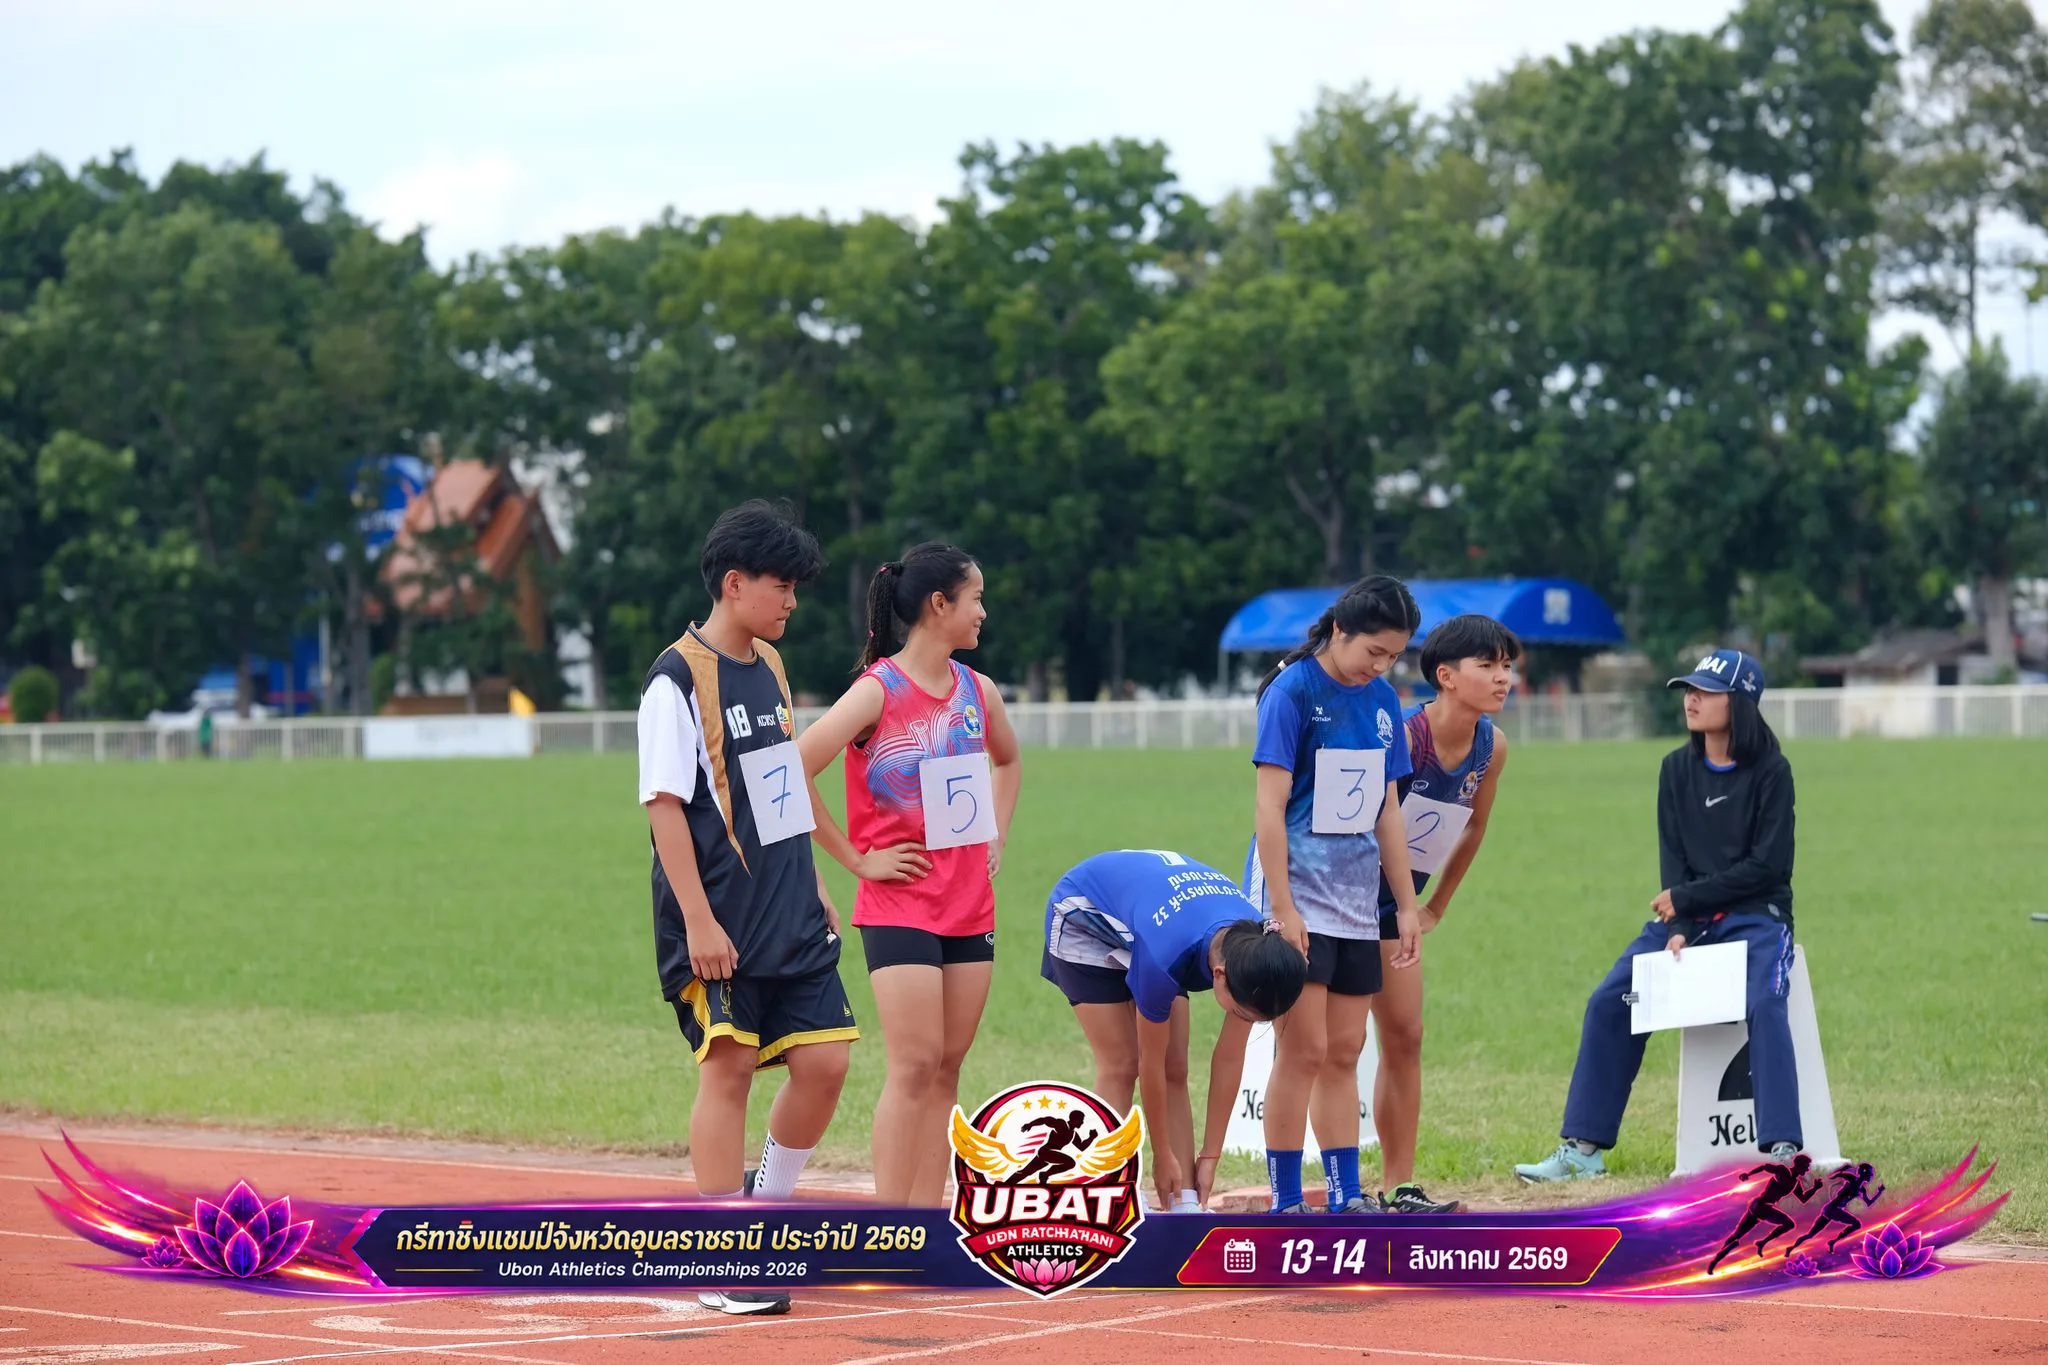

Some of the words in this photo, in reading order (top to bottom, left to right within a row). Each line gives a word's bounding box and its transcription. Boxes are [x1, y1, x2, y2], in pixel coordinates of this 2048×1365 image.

[725, 703, 753, 740] 18
[762, 763, 792, 819] 7
[945, 773, 978, 834] 5
[1335, 767, 1368, 822] 3
[1407, 810, 1441, 855] 2
[1152, 905, 1170, 927] 32
[1241, 1088, 1264, 1121] Ne
[1708, 1112, 1758, 1147] Nel
